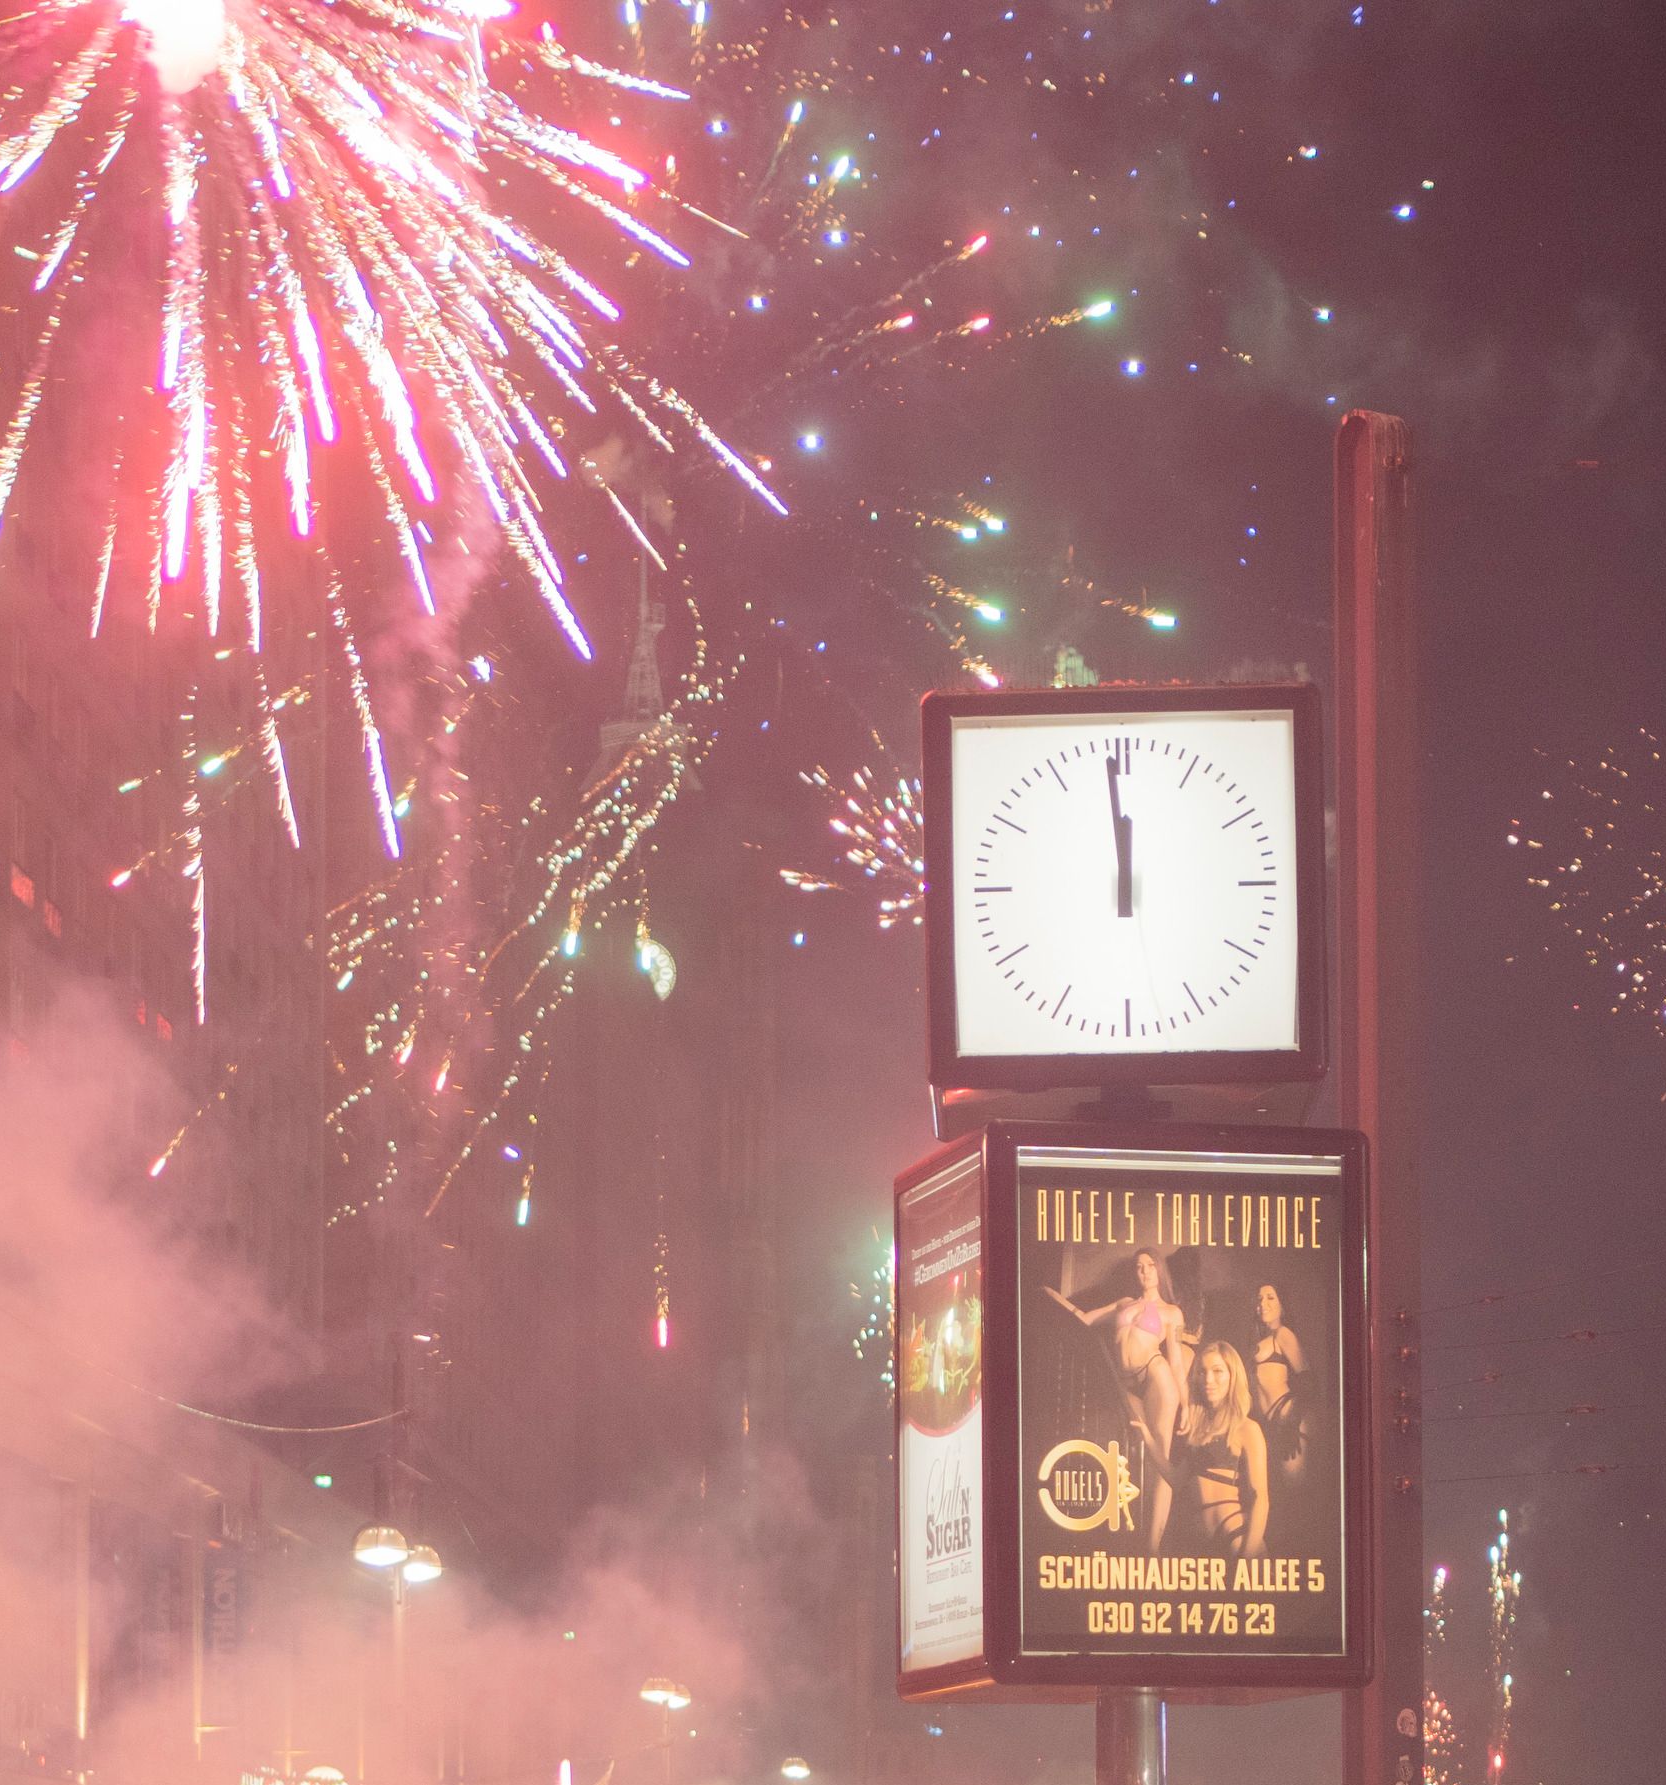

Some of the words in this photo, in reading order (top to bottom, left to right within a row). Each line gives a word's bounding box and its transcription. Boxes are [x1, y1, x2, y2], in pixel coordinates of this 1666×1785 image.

[1037, 1189, 1135, 1245] ANGELS
[1156, 1193, 1321, 1249] TABLEDANCE
[1055, 1470, 1102, 1501] ANGELS
[926, 1513, 972, 1559] SUGAR
[1039, 1551, 1225, 1592] SCHÖNHAUSER
[1233, 1558, 1301, 1592] ALLEE
[1306, 1559, 1324, 1592] 5
[1088, 1602, 1134, 1633] 030
[1141, 1602, 1172, 1633] 92
[1178, 1603, 1203, 1634] 14
[1209, 1603, 1238, 1634] 76
[1245, 1603, 1275, 1635] 23
